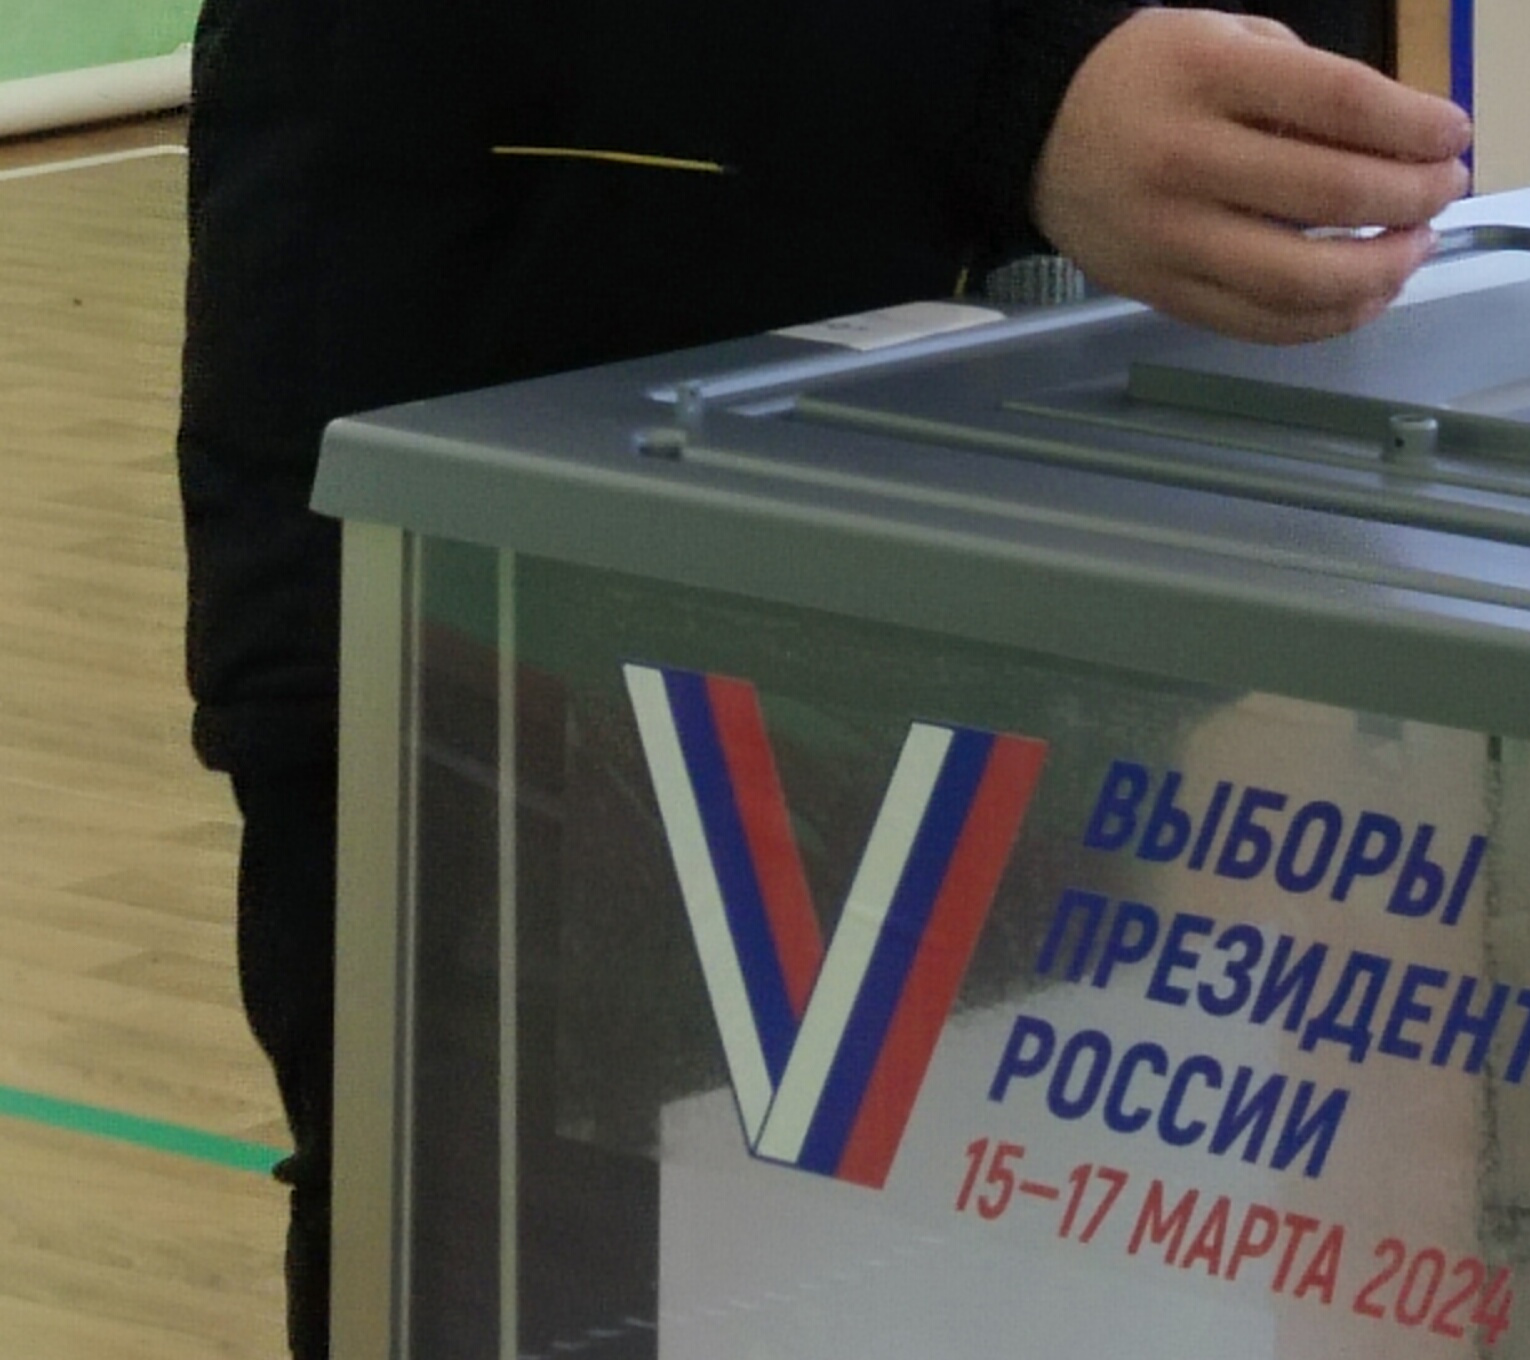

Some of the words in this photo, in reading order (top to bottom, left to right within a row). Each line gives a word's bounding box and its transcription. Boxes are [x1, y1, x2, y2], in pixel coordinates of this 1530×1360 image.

[1084, 760, 1488, 926] ВЫБОРЫ
[988, 1015, 1352, 1178] РОССИИ
[1127, 1192, 1345, 1304] МАРТА
[1352, 1237, 1514, 1346] 2024
